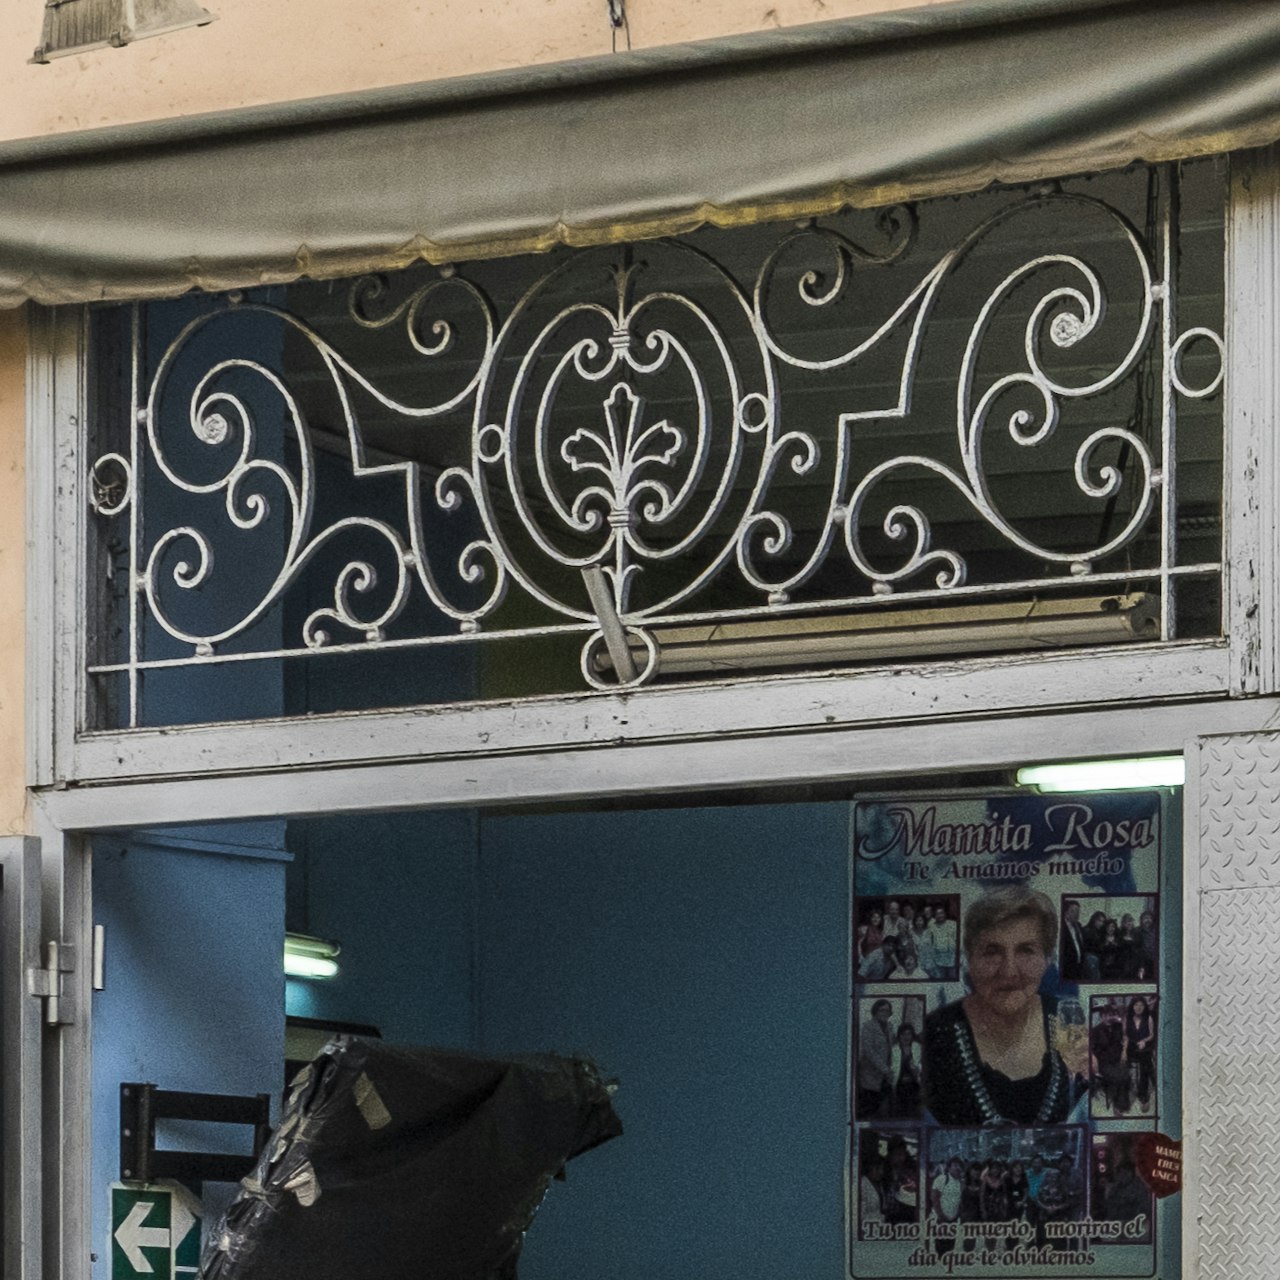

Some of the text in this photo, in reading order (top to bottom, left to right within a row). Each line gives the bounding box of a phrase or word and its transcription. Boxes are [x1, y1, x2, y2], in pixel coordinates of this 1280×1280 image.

[858, 802, 1155, 861] Mamita Rosa
[903, 852, 1125, 881] Te Amamos mucho
[863, 1220, 893, 1240] Tu
[894, 1224, 920, 1240] no
[925, 1217, 958, 1239] has
[1123, 1215, 1144, 1239] el
[1001, 1244, 1096, 1267] olvidemos
